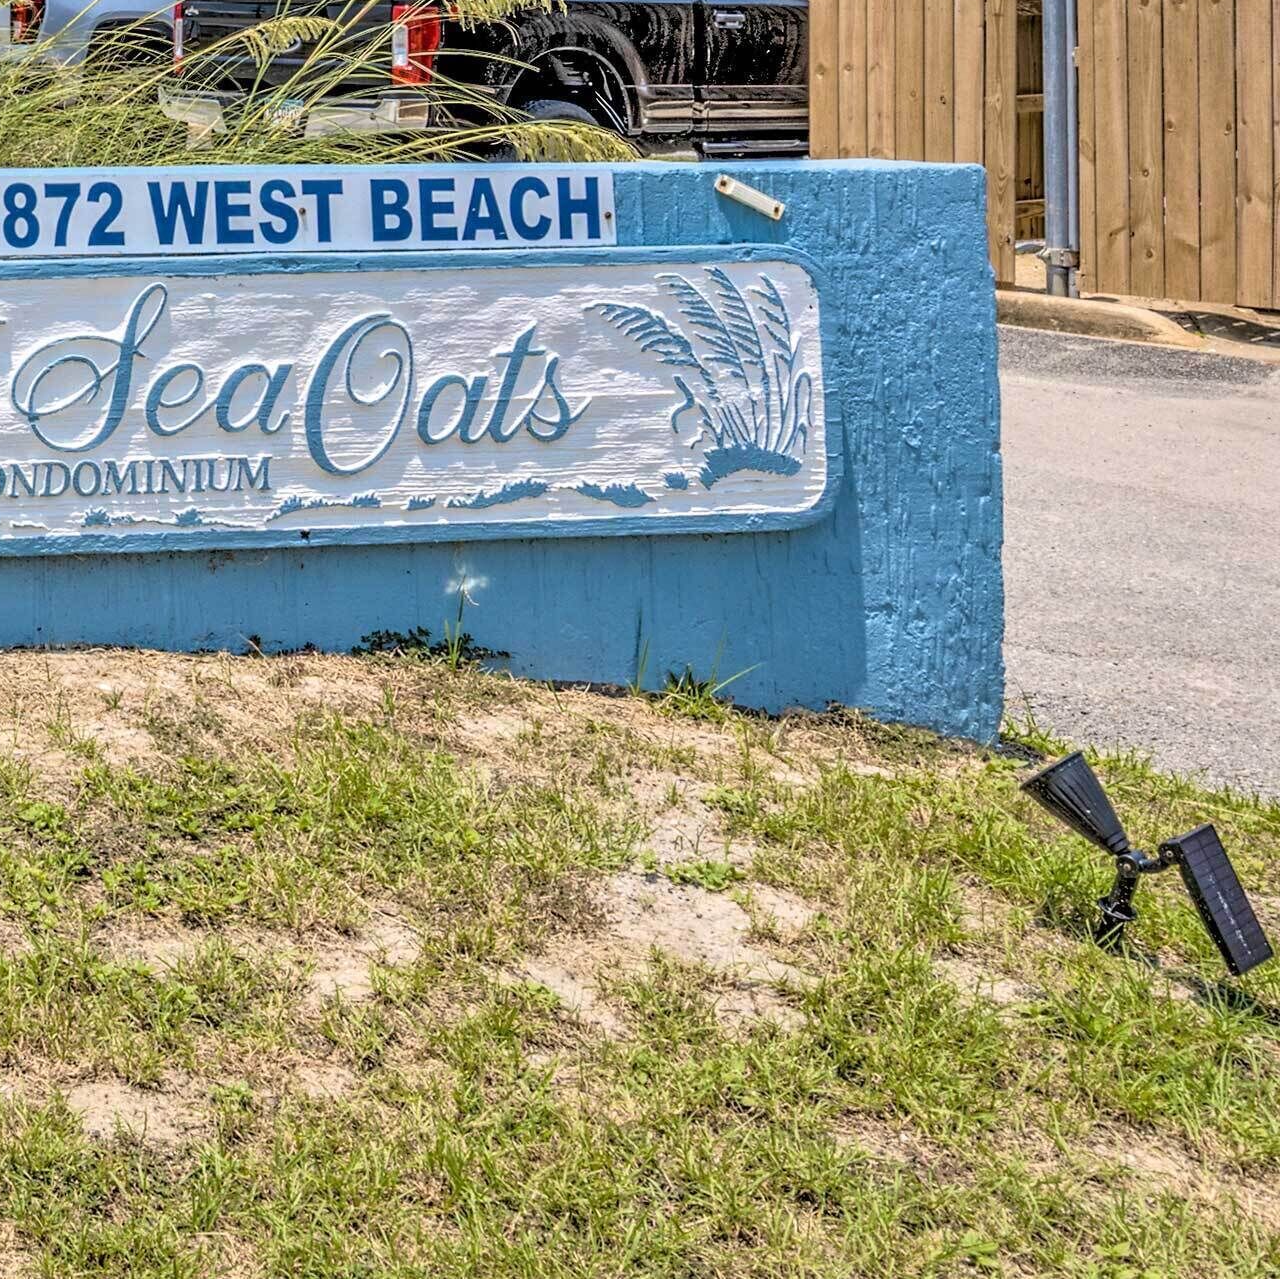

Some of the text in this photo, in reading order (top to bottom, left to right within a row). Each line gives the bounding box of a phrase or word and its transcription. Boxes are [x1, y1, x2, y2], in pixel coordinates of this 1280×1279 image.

[147, 178, 344, 246] WEST
[369, 175, 602, 243] BEACH
[11, 281, 592, 477] Sea Oats
